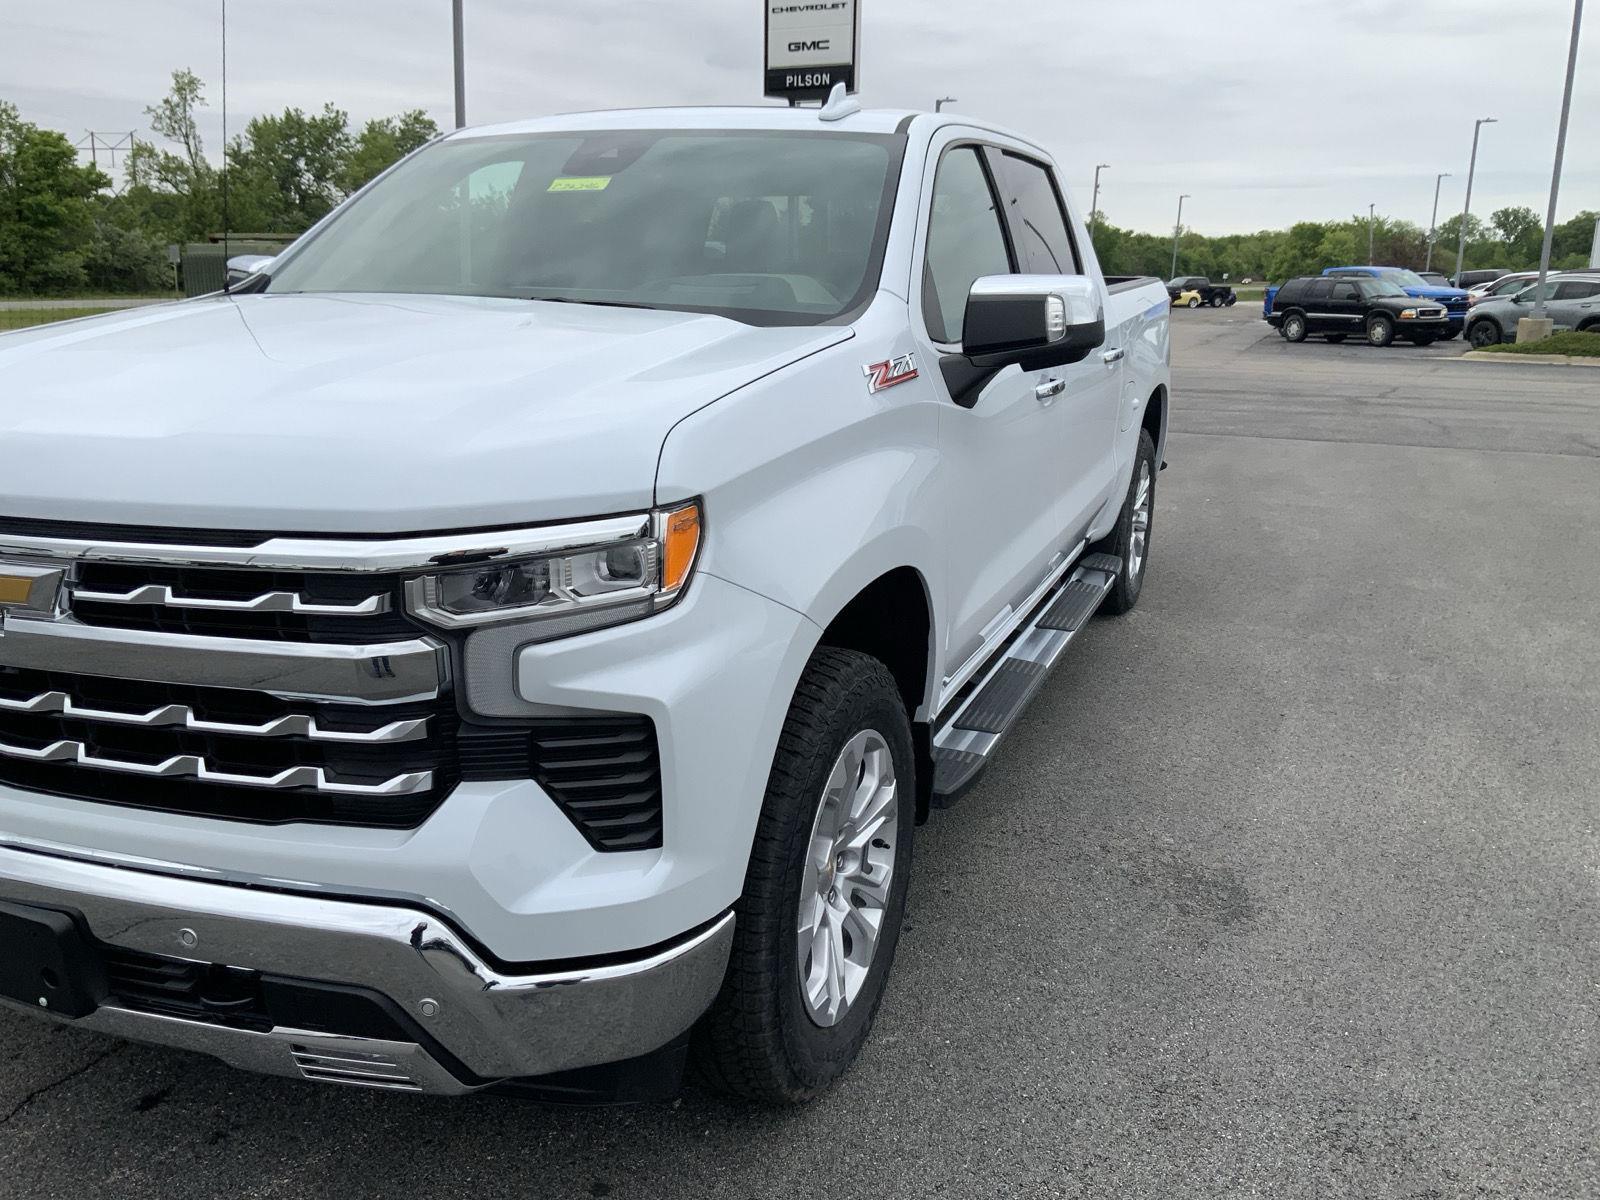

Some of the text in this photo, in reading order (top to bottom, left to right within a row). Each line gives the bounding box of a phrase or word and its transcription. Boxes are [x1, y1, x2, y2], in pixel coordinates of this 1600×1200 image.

[772, 2, 848, 14] CHEVROLET
[788, 40, 830, 52] GMC
[786, 73, 830, 87] PILSON
[861, 352, 919, 395] Z71
